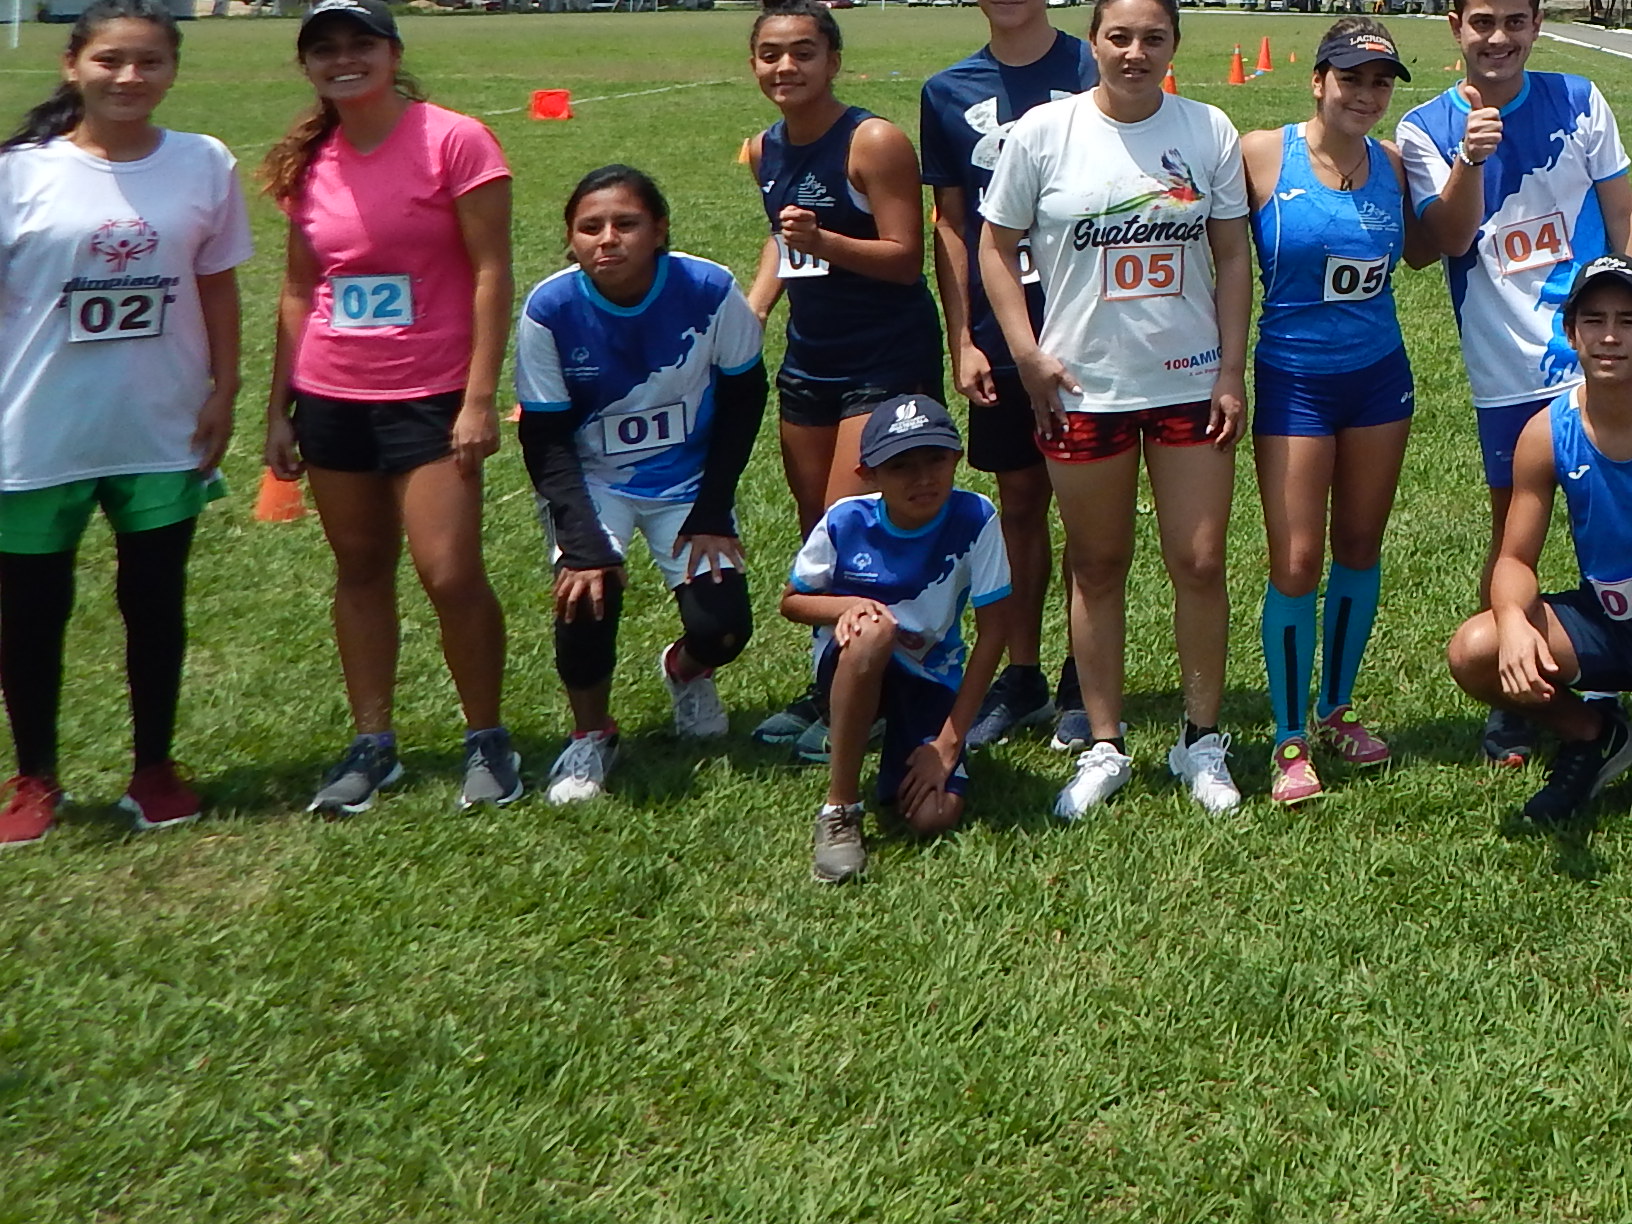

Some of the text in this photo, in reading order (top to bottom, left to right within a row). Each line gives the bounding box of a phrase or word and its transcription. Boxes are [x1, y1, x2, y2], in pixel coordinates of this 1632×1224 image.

[1505, 222, 1562, 262] 04
[1114, 253, 1176, 290] 05
[1332, 262, 1386, 294] 05
[80, 294, 153, 334] 02
[343, 282, 403, 320] 02
[618, 411, 670, 445] 01
